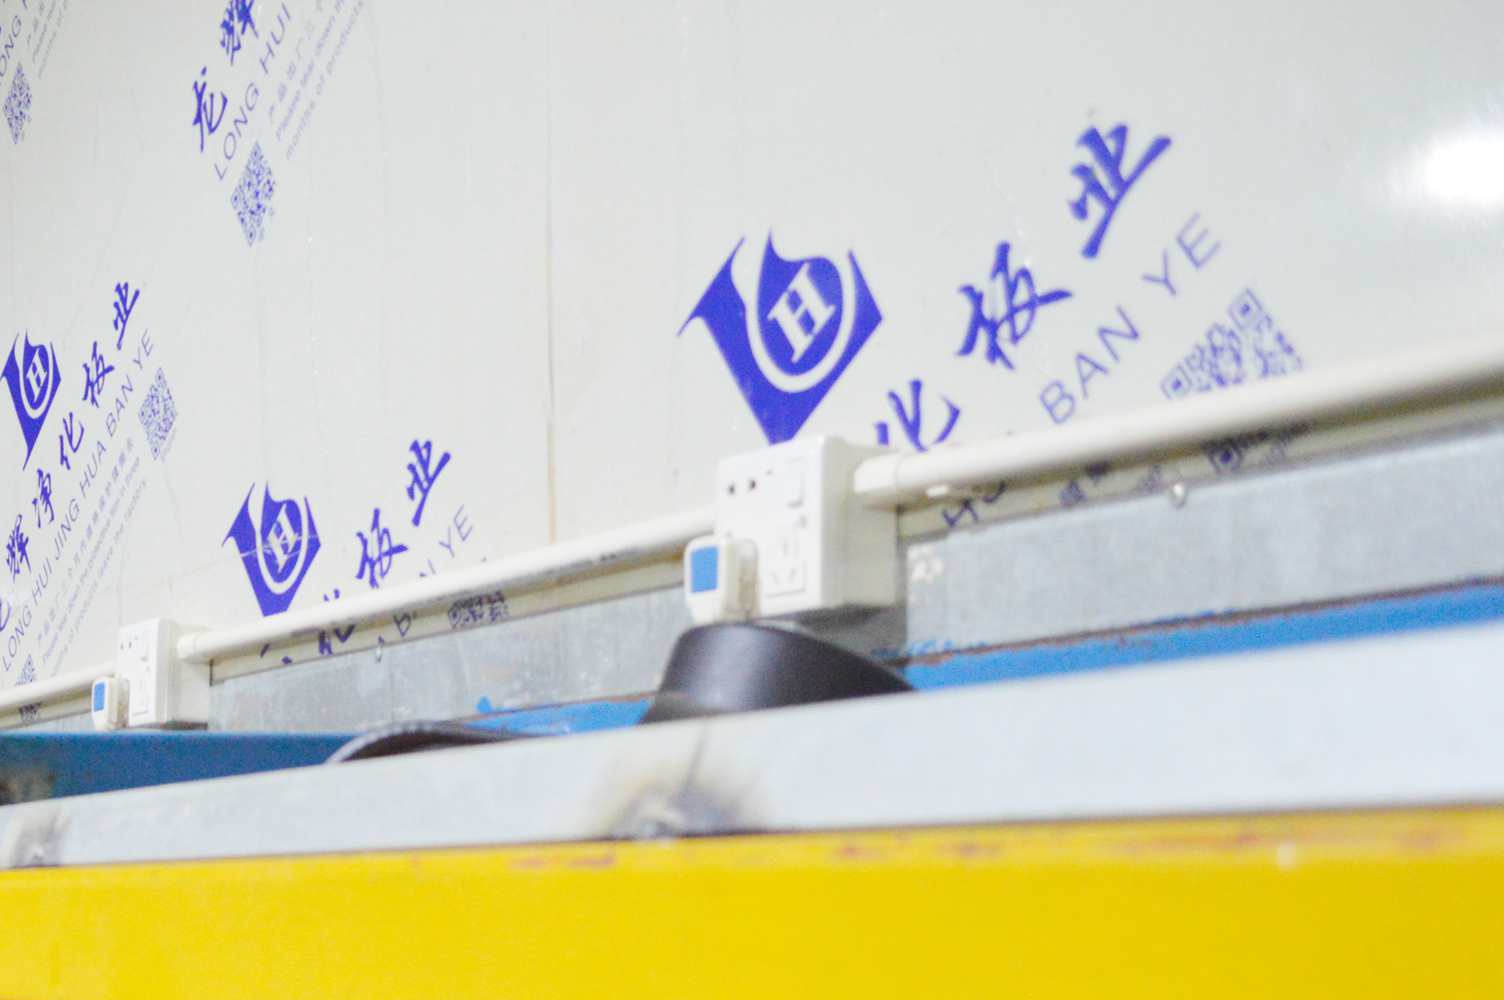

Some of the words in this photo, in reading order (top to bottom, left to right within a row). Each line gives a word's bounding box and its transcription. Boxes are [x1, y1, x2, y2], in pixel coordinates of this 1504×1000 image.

[214, 82, 260, 180] LONG
[259, 2, 291, 74] HUI
[1039, 305, 1139, 424] BAN
[1142, 213, 1222, 296] YE
[2, 604, 33, 671] LONG
[31, 558, 52, 606] HUI
[55, 498, 80, 561] JING
[79, 440, 106, 498] HUA
[105, 375, 133, 437] BAN
[133, 328, 153, 370] YE
[439, 504, 473, 558] YE
